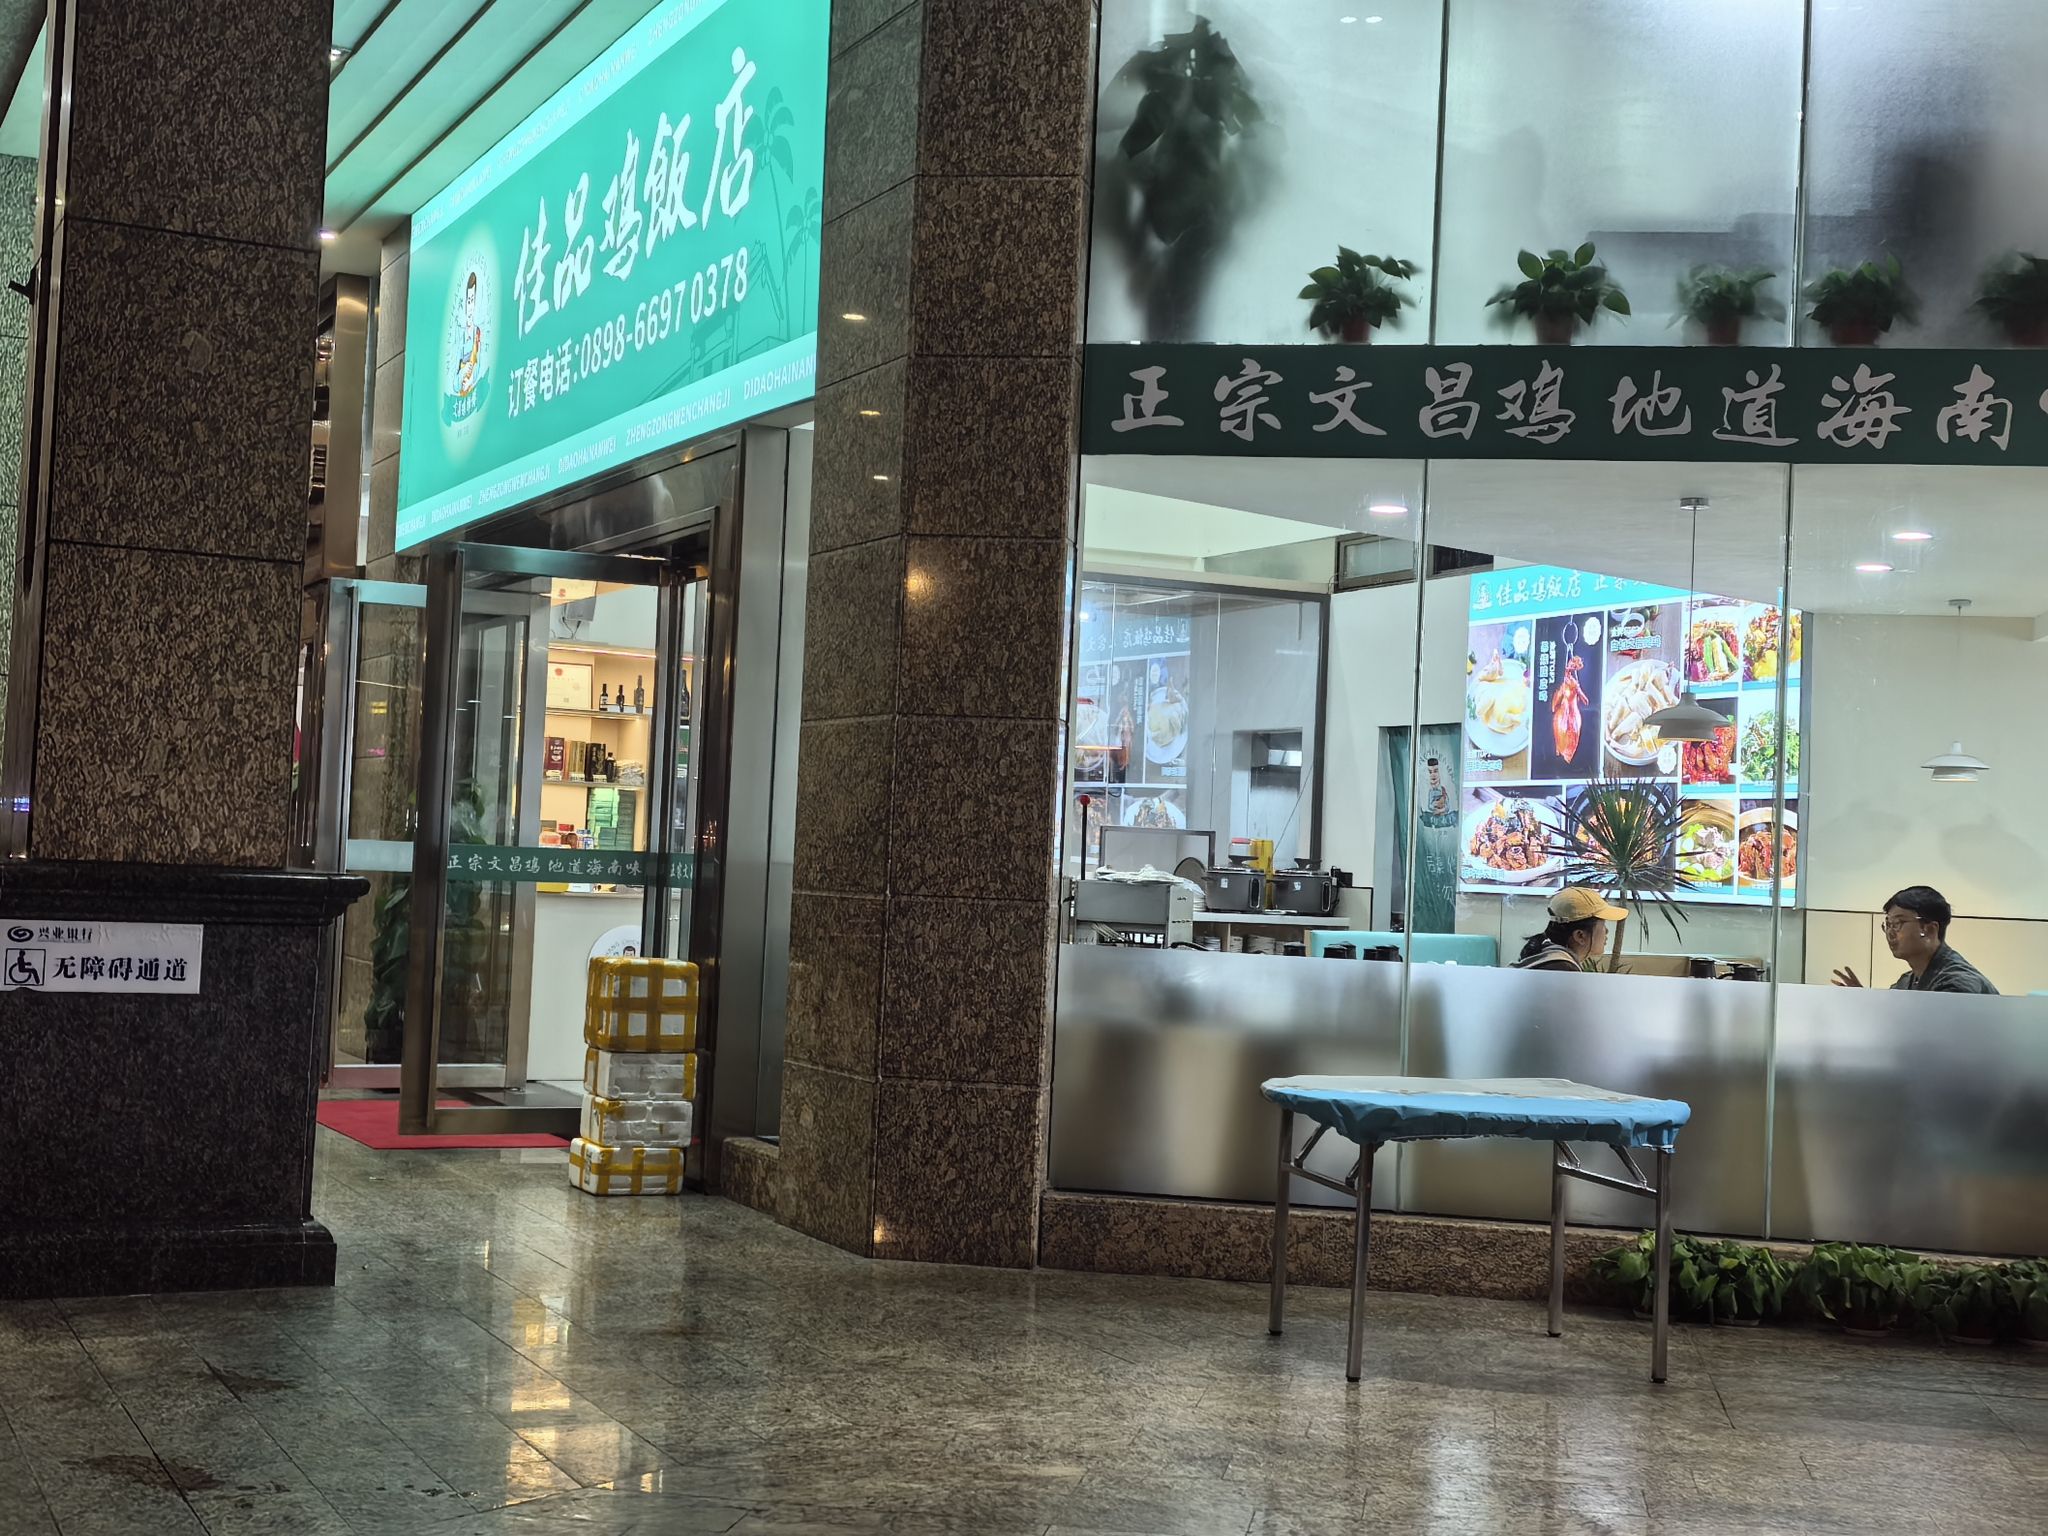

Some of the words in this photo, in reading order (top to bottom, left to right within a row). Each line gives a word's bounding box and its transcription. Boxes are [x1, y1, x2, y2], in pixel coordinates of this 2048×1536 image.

[626, 388, 731, 447] ZHENGZONGWENCHANGJI
[1109, 359, 2048, 451] 正宗文昌鸡地道海南
[37, 926, 93, 942] 兴业银行
[52, 955, 188, 982] 无障碍通道
